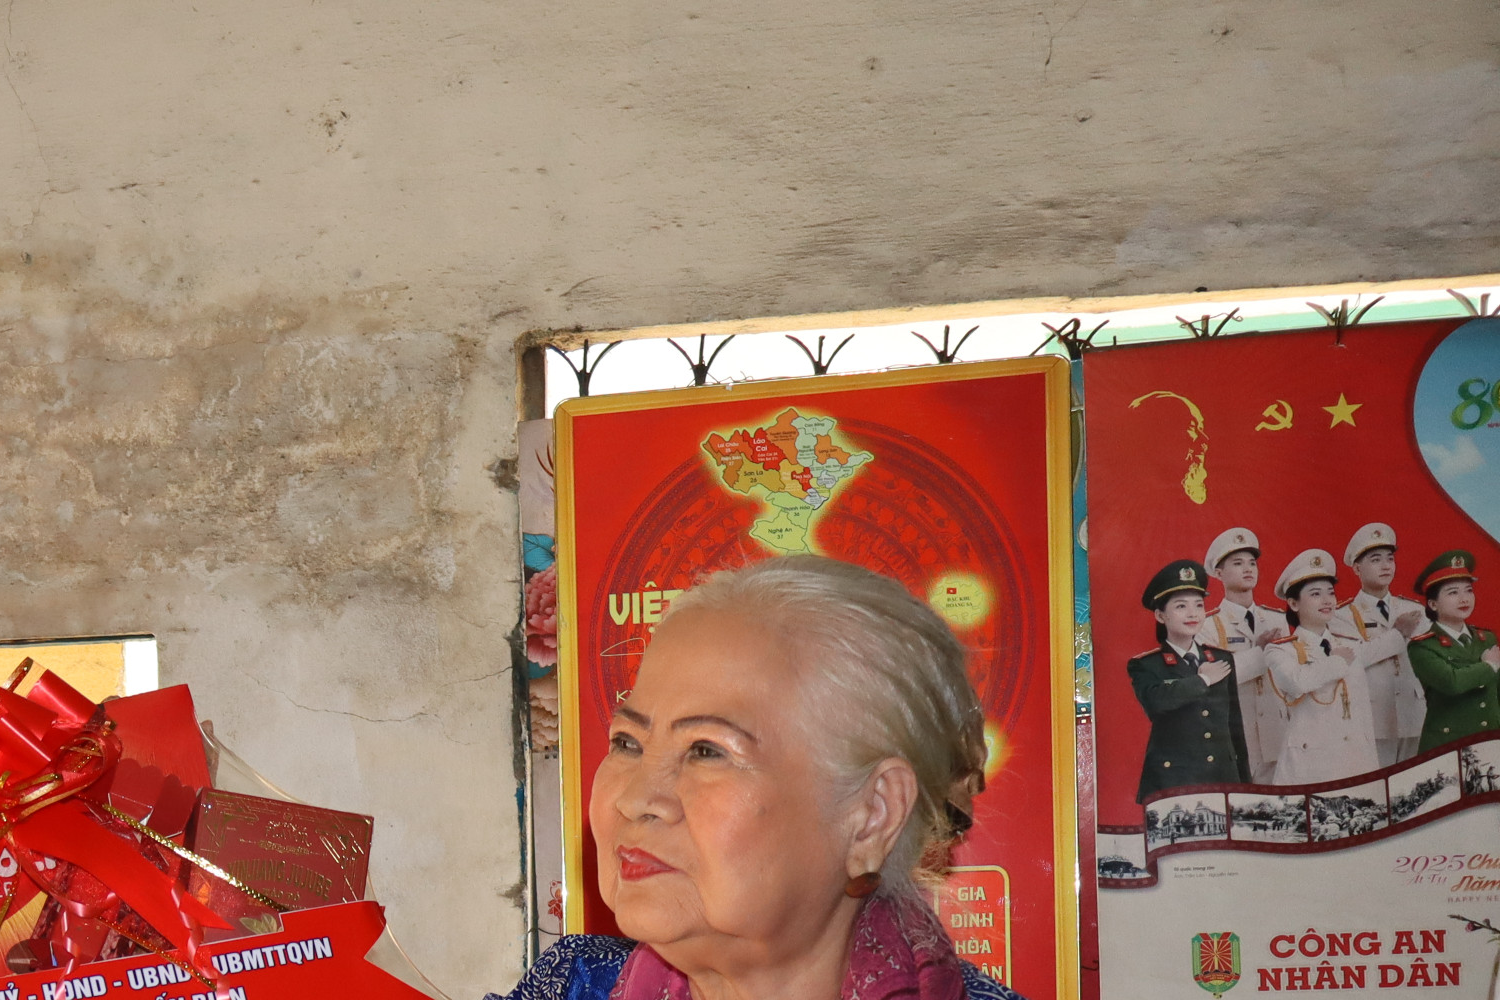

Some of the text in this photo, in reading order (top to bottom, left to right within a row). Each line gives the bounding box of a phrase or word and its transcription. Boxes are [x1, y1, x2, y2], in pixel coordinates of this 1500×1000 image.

[1391, 855, 1466, 873] 2025
[957, 886, 986, 901] GIA
[955, 936, 992, 954] HÒA
[1269, 928, 1446, 958] CÔNG AN
[1257, 958, 1461, 991] NHÂN DÂN
